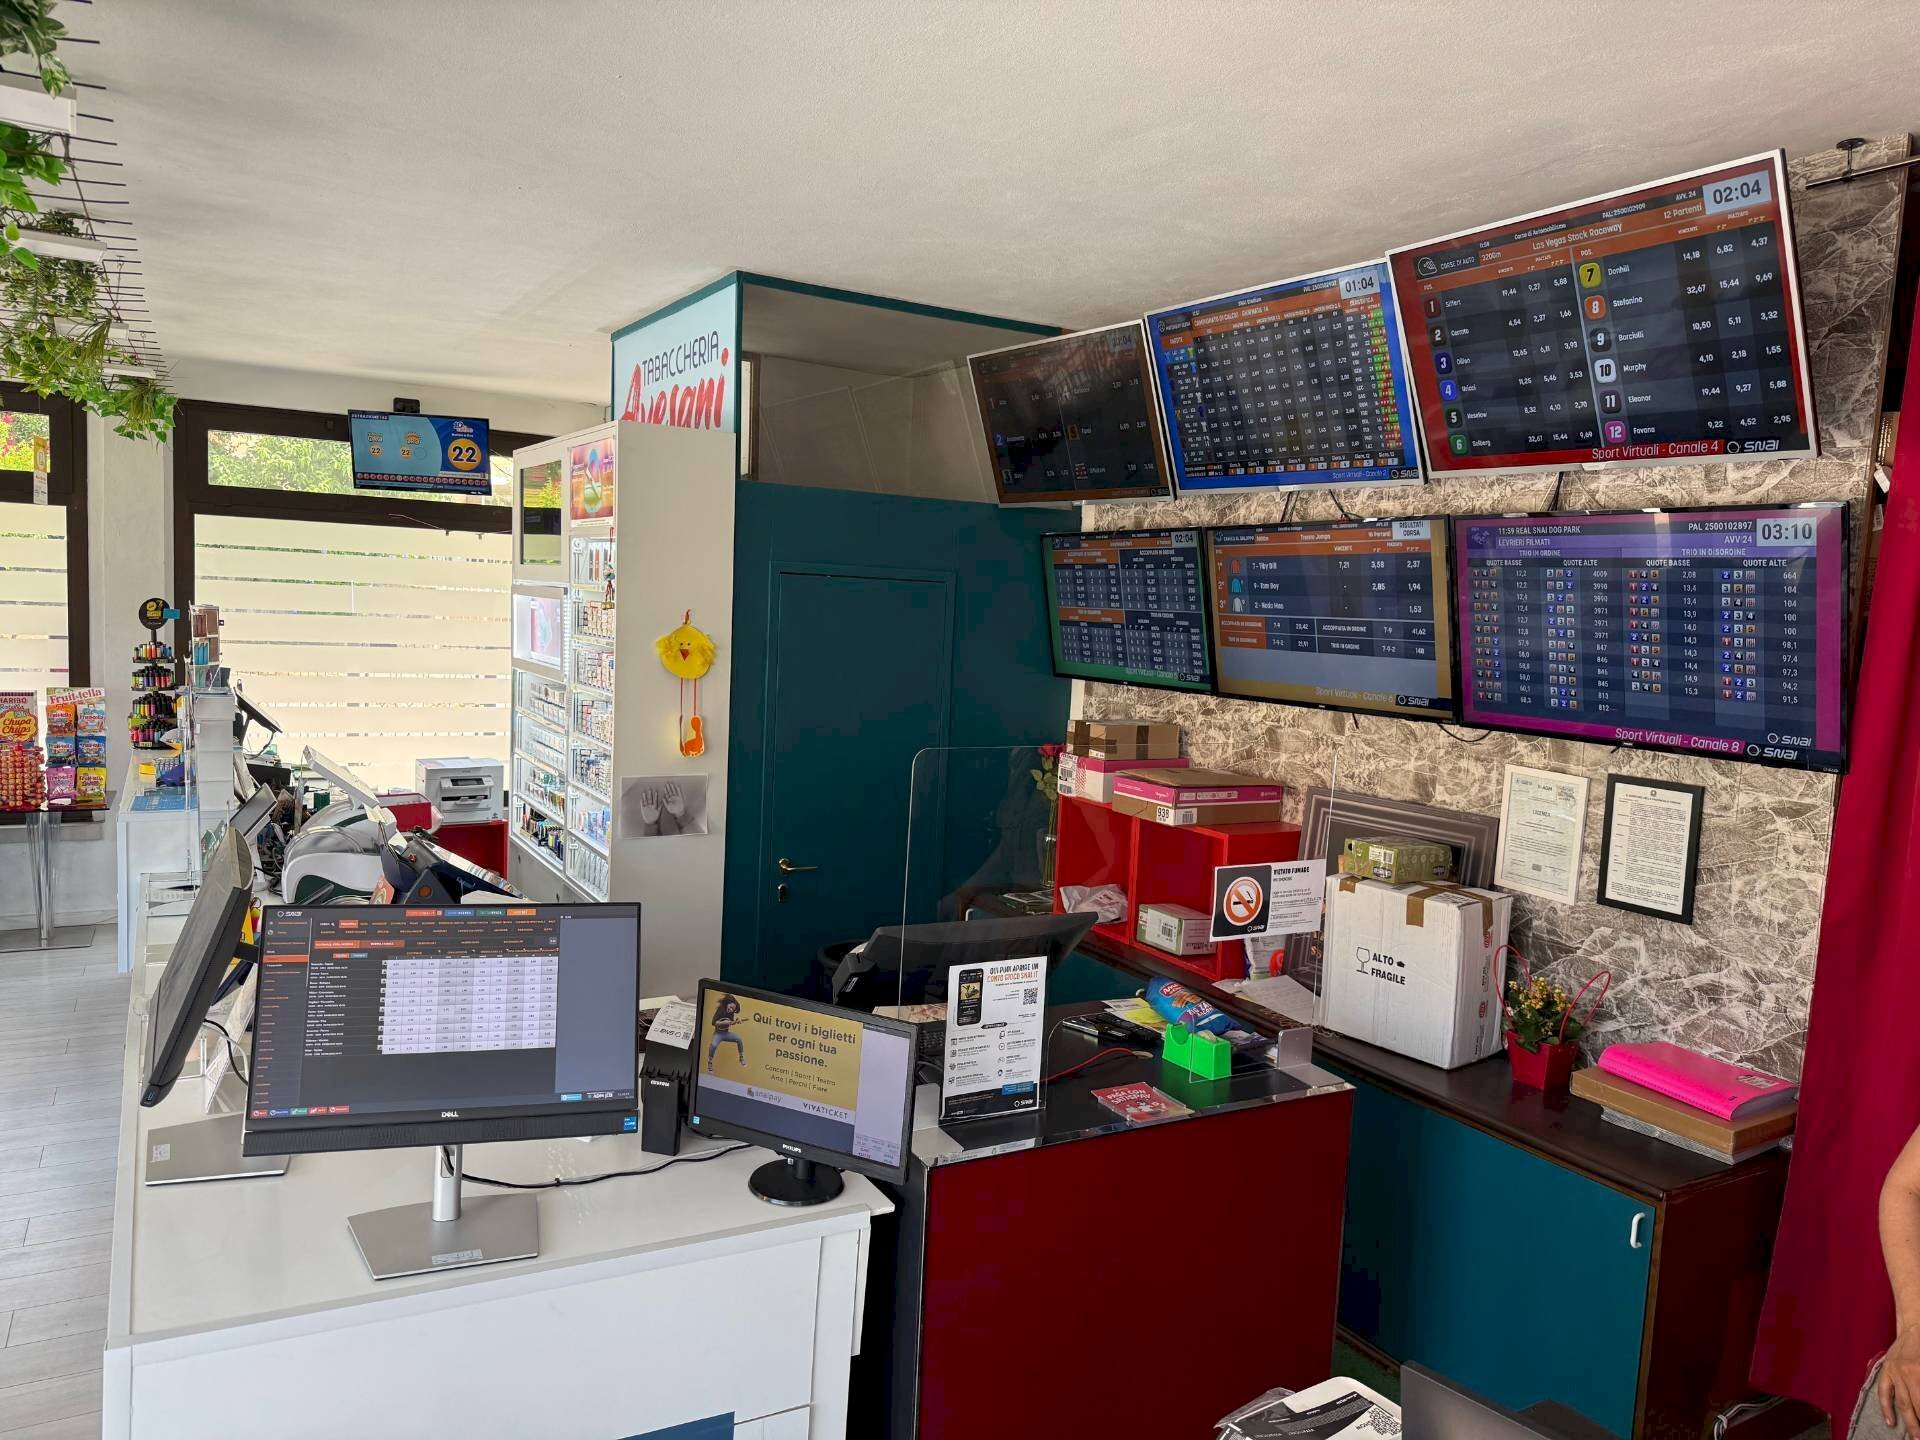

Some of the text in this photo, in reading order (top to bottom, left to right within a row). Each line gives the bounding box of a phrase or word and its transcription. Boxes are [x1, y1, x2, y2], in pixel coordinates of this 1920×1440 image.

[1712, 179, 1762, 204] 02:04
[1664, 211, 1672, 219] 12
[1568, 231, 1588, 242] Stock
[1586, 237, 1768, 282] 7 14,18 6,82 4,37
[1345, 276, 1374, 293] 01:04
[1591, 272, 1773, 313] 8 32,67 15,44 9,69
[1430, 301, 1434, 312] 1
[1435, 329, 1441, 340] 2
[1598, 311, 1778, 346] 9 10,50 5,11 3,32
[642, 331, 718, 386] TABACCHERIA
[1440, 358, 1446, 368] 3
[1600, 364, 1612, 377] 10
[1699, 354, 1714, 363] 4,10
[1732, 350, 1747, 359] 2,18
[1766, 346, 1781, 355] 1,55
[1445, 385, 1451, 396] 4
[1605, 380, 1787, 408] 11 19,44 9,27 5,88
[1451, 412, 1457, 423] 5
[1609, 415, 1791, 439] 12 9,22 4,52 2,95
[1456, 439, 1462, 449] 6
[1592, 440, 1719, 460] Sport Virtuali Canale 4
[452, 446, 477, 463] 22
[1688, 522, 1752, 531] PAL 2500102897
[1761, 523, 1812, 540] 03:10
[1174, 534, 1194, 543] 02:04
[1407, 560, 1420, 569] 2,37
[1408, 583, 1421, 591] 1,94
[1409, 605, 1422, 613] 1,53
[1782, 655, 1798, 663] 97,4
[1782, 682, 1798, 690] 94,2
[1782, 696, 1798, 704] 91,5
[2, 726, 31, 734] Chups
[1615, 728, 1739, 751] Sport Virtuali Canale 8
[1372, 953, 1394, 966] ALTO
[1371, 968, 1406, 985] FRAGILE
[753, 1012, 856, 1044] Qui trovi i biglietti
[768, 1032, 837, 1055] per ogni tua
[776, 1048, 828, 1068] passione.
[802, 1102, 848, 1119] VIVATICKET
[782, 1144, 802, 1153] PHILIPS
